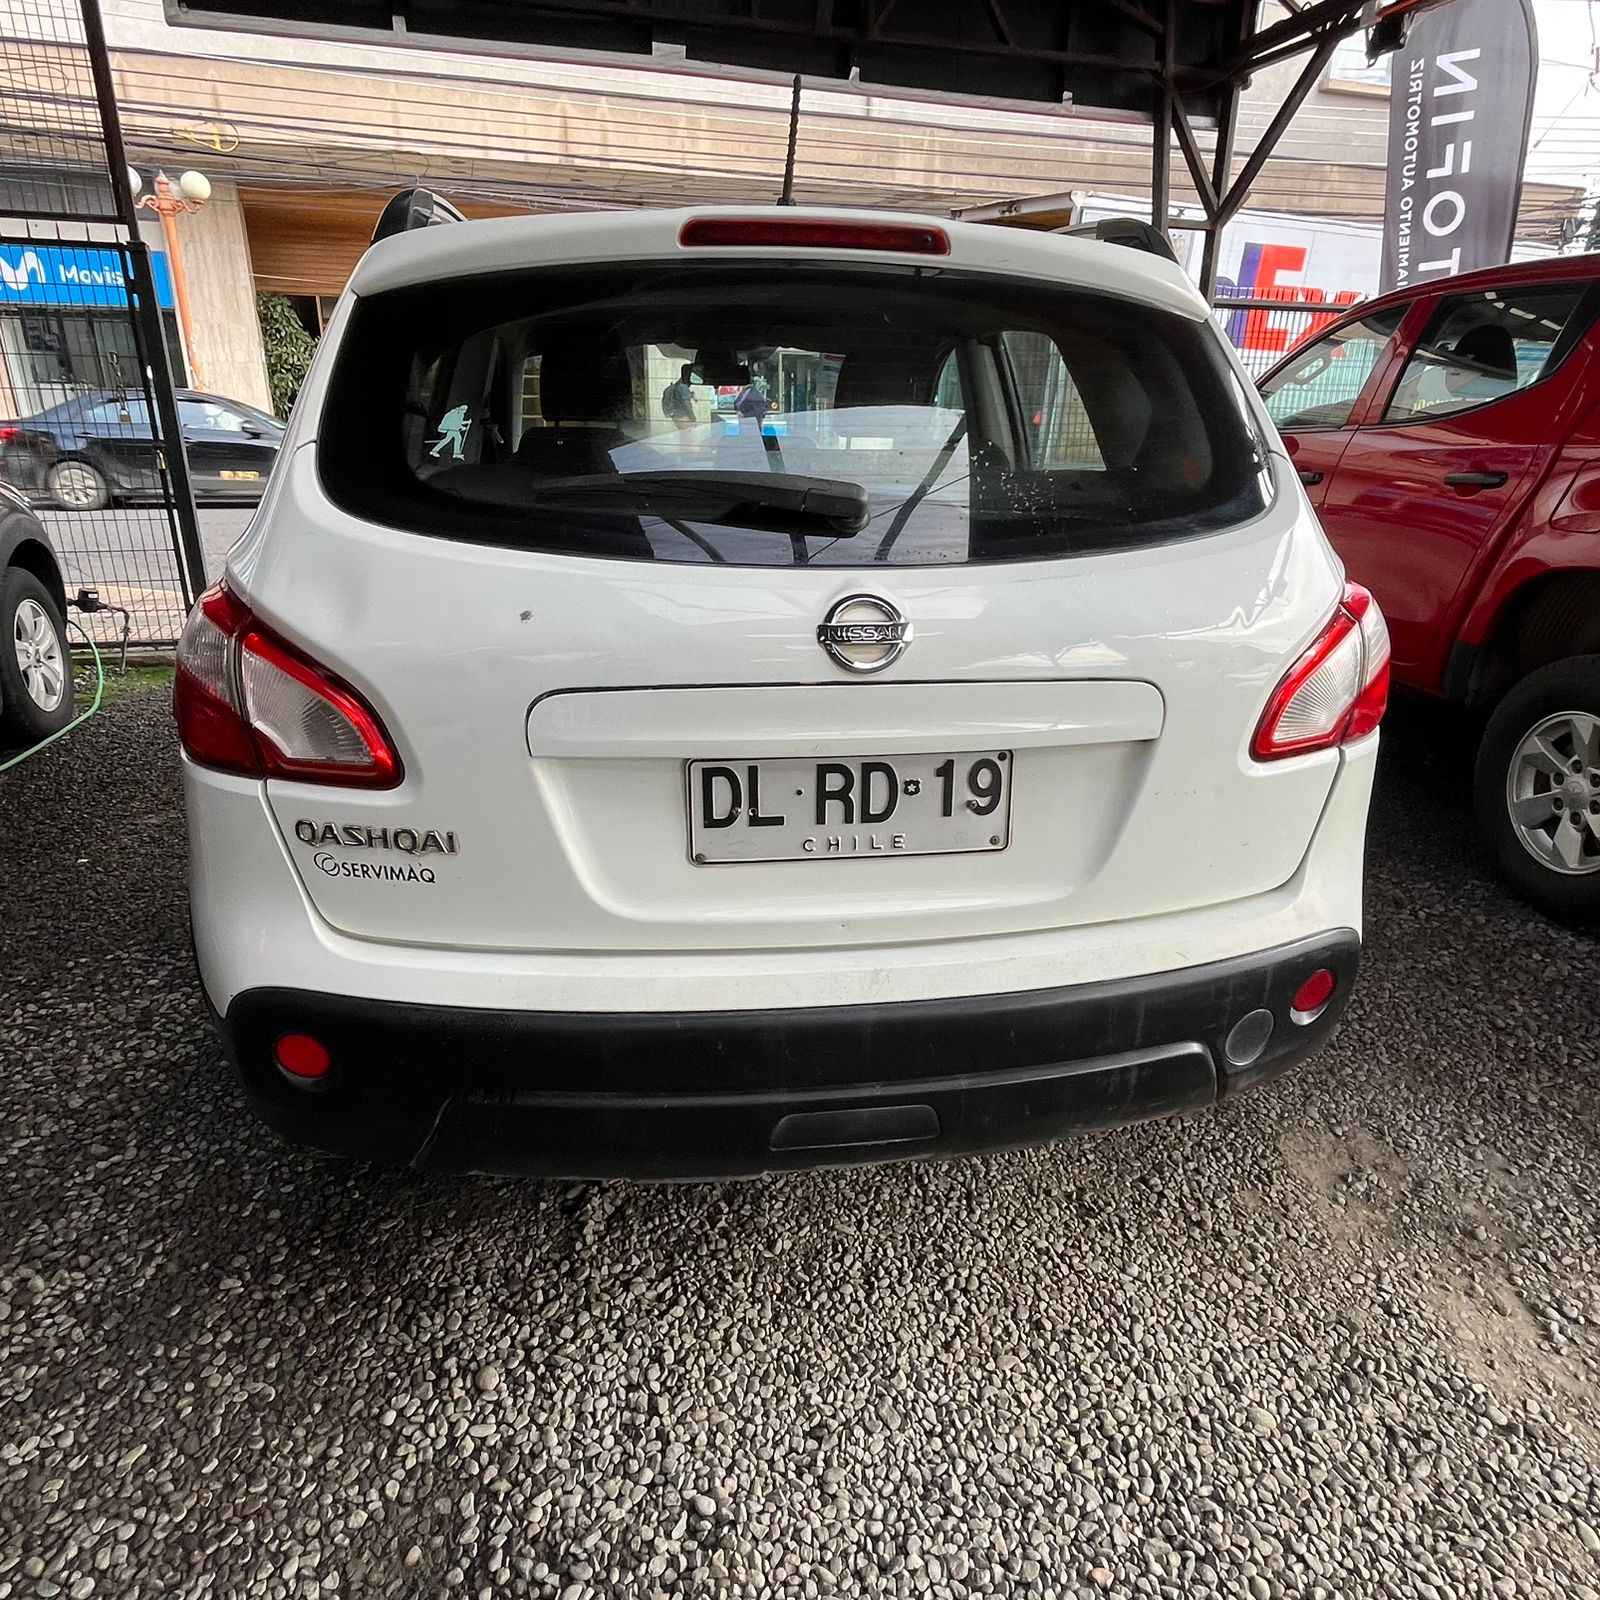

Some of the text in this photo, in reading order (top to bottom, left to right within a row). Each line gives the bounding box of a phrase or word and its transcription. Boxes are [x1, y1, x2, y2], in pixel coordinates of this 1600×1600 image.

[827, 625, 902, 641] NISSAN
[935, 758, 1002, 817] 19
[295, 819, 458, 855] QASHQAI
[803, 834, 906, 852] CHILE
